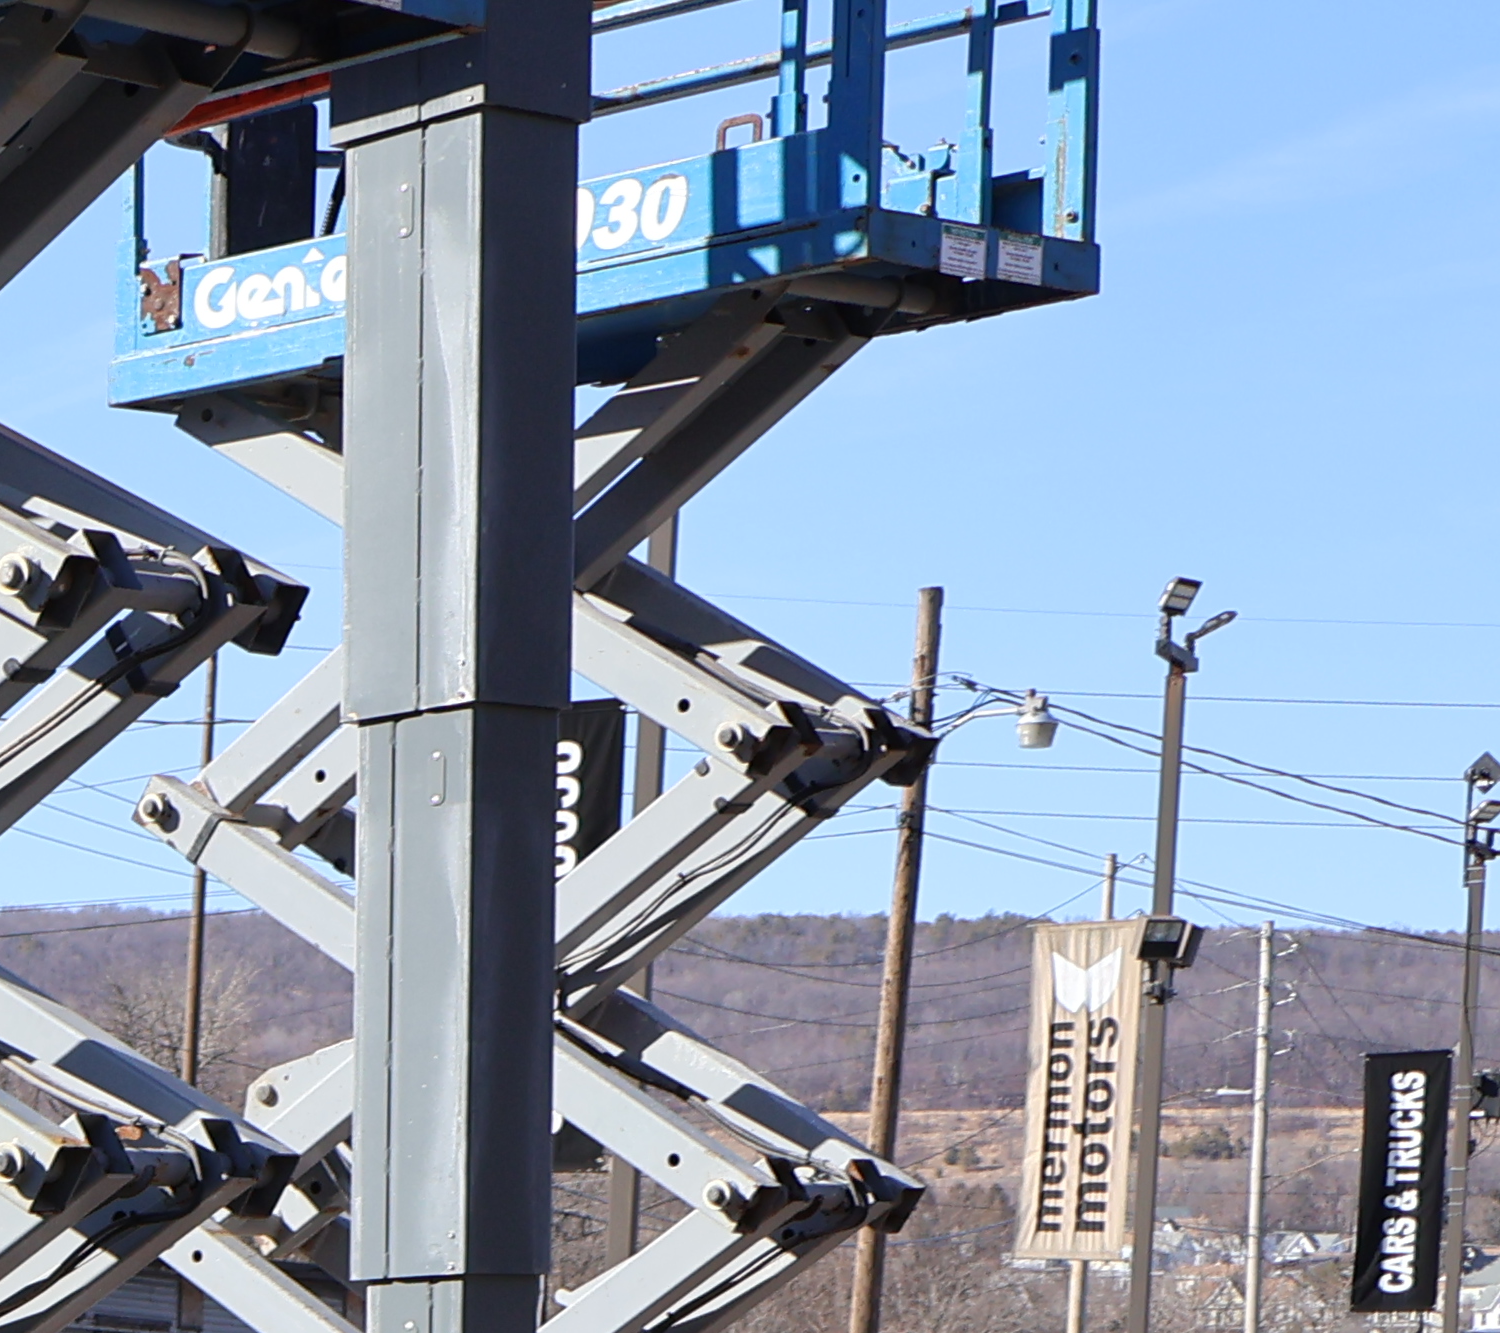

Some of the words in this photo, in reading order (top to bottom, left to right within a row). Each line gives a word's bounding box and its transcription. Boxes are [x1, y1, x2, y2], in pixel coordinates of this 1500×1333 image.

[1070, 1016, 1119, 1233] motors
[1385, 1069, 1427, 1187] TRUCKS
[1383, 1188, 1420, 1212] &
[1377, 1216, 1418, 1293] CARS
